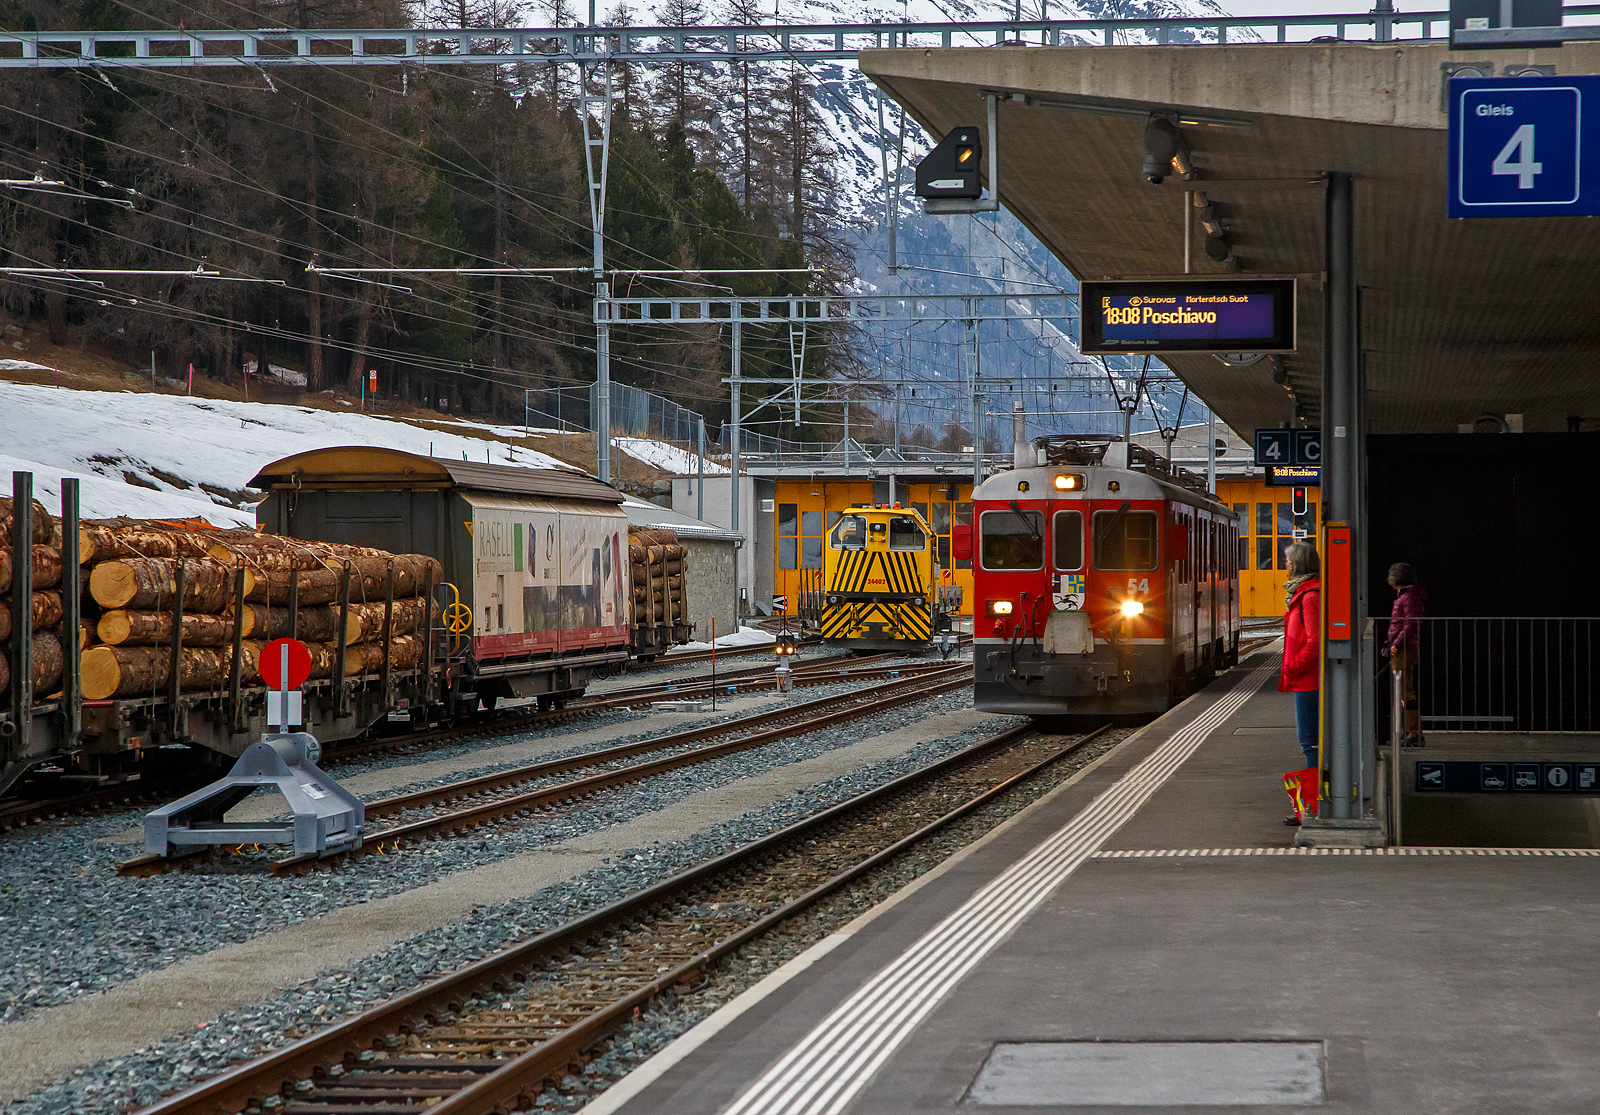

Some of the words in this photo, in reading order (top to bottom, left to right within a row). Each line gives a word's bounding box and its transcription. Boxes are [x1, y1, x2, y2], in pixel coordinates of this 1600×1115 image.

[1476, 104, 1514, 116] Gleis
[1491, 124, 1543, 189] 4
[1143, 296, 1176, 304] Surovas
[1229, 295, 1249, 303] Suot
[1103, 307, 1140, 324] 18:08
[1142, 306, 1217, 324] Poschiavo
[1266, 442, 1281, 459] 4
[1305, 442, 1320, 459] C
[480, 521, 513, 557] RASELLI
[1127, 578, 1150, 594] 54
